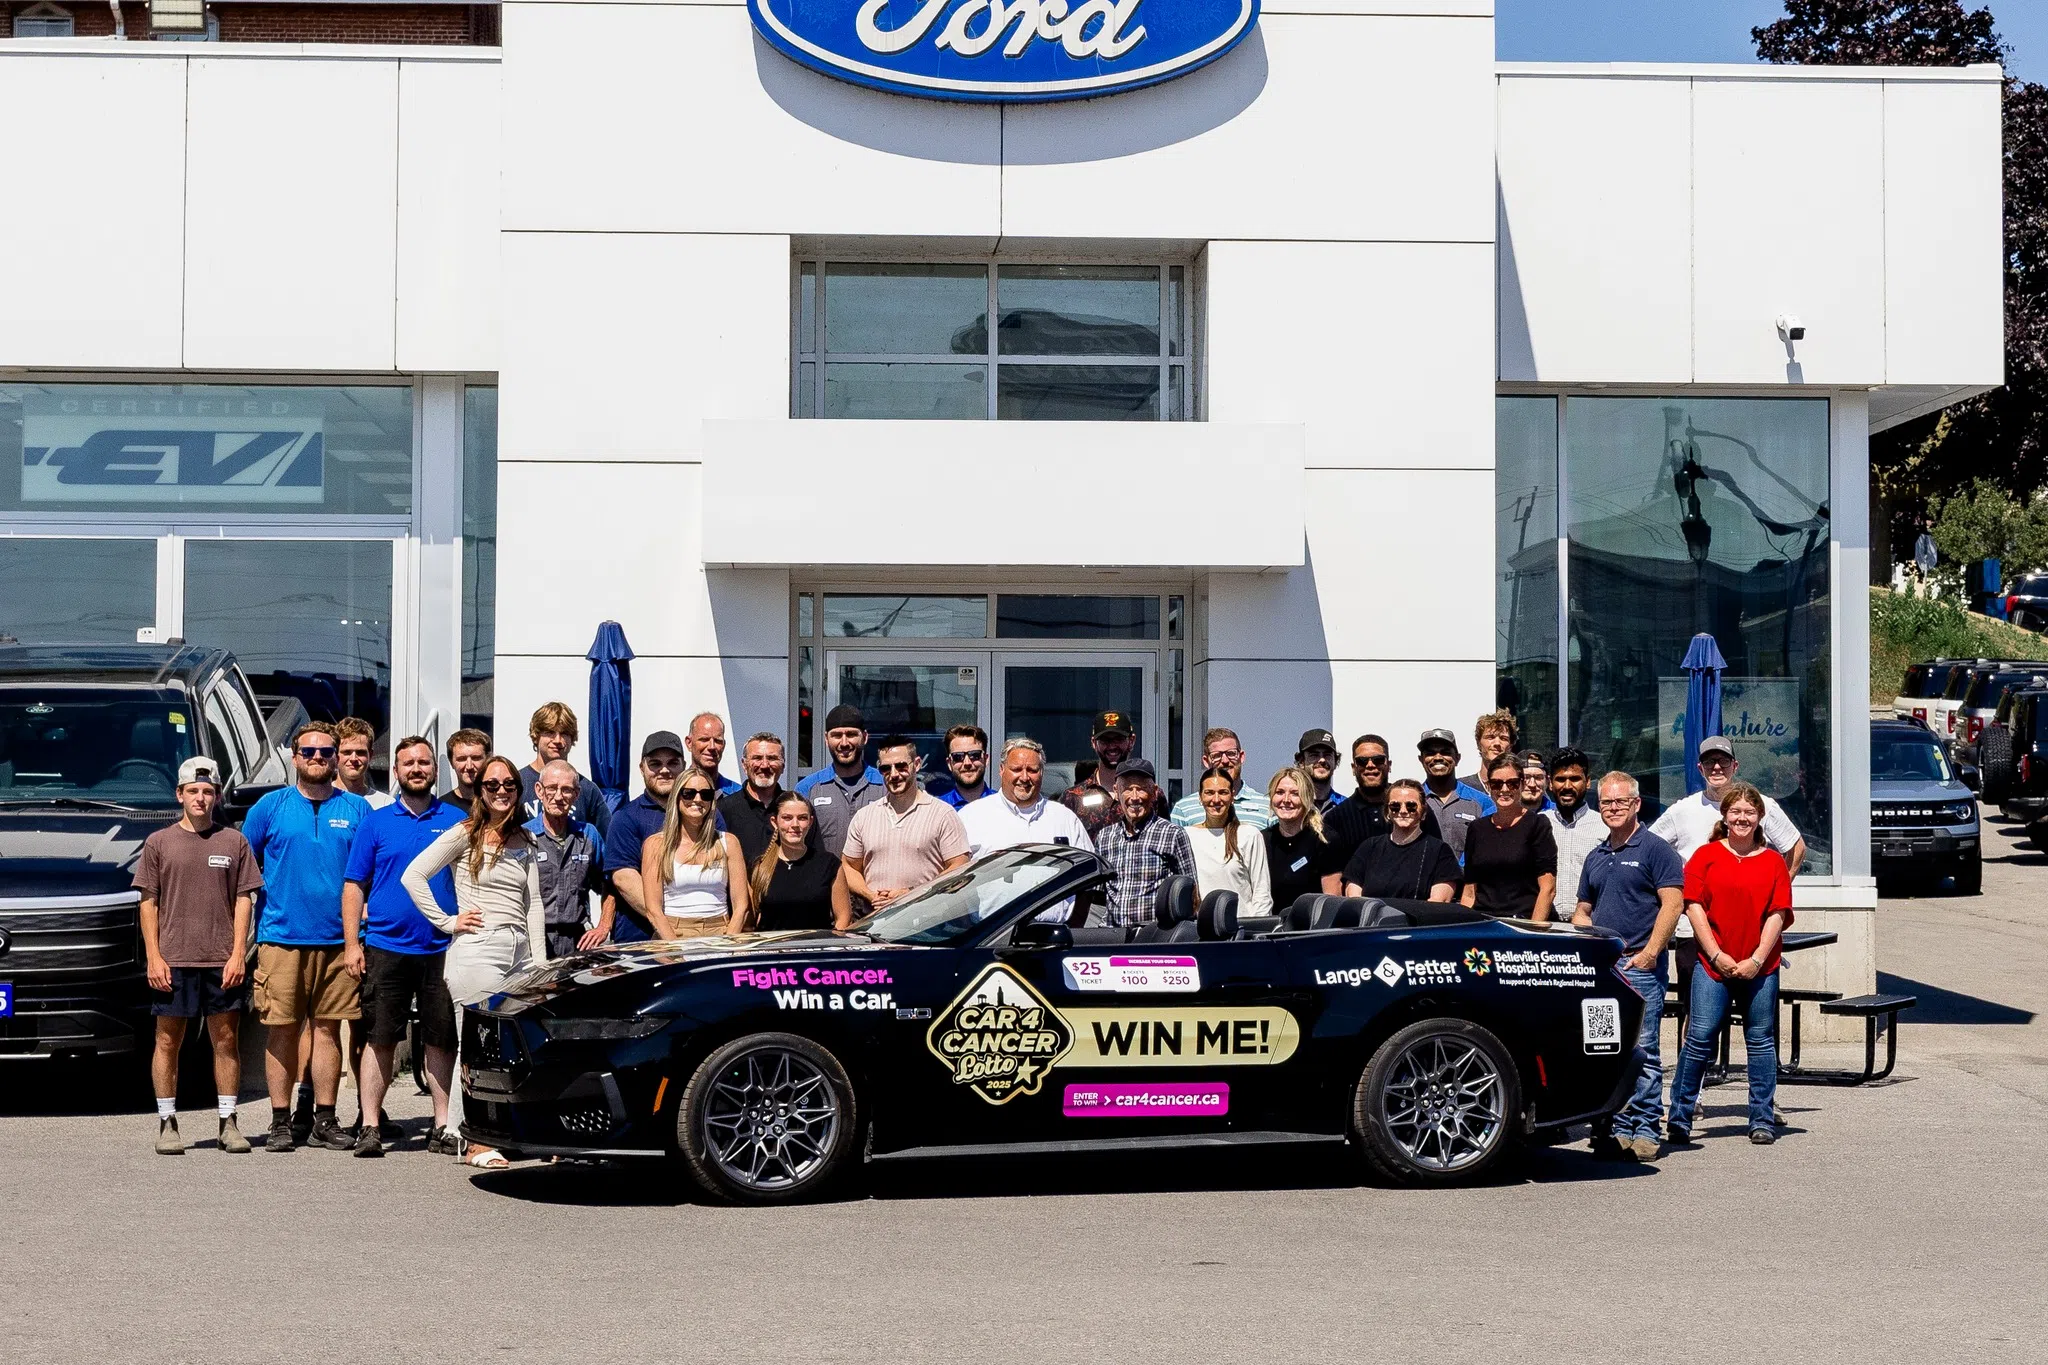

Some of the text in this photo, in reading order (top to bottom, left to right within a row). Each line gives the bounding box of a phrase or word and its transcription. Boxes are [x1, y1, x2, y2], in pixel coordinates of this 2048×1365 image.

[60, 400, 291, 414] CERTIFIED
[1671, 710, 1789, 739] Anture
[1492, 950, 1581, 963] Belleville General
[1072, 962, 1102, 976] $25
[1313, 959, 1458, 987] Lange & Fetter
[1495, 962, 1596, 976] Hospital Foundation
[732, 967, 893, 989] Fight Cancer.
[1121, 976, 1148, 985] $100
[1162, 976, 1190, 985] $250
[1408, 975, 1462, 986] MOTORS
[1506, 979, 1525, 987] support
[1526, 978, 1532, 987] of
[773, 989, 897, 1010] Win a Car.
[959, 1009, 1040, 1029] CAR 4
[943, 1032, 1056, 1052] CANCER
[1091, 1020, 1270, 1056] WIN ME!
[954, 1054, 1015, 1081] Lotto
[986, 1080, 1011, 1089] 2025
[1115, 1092, 1220, 1106] car4cancer.ca
